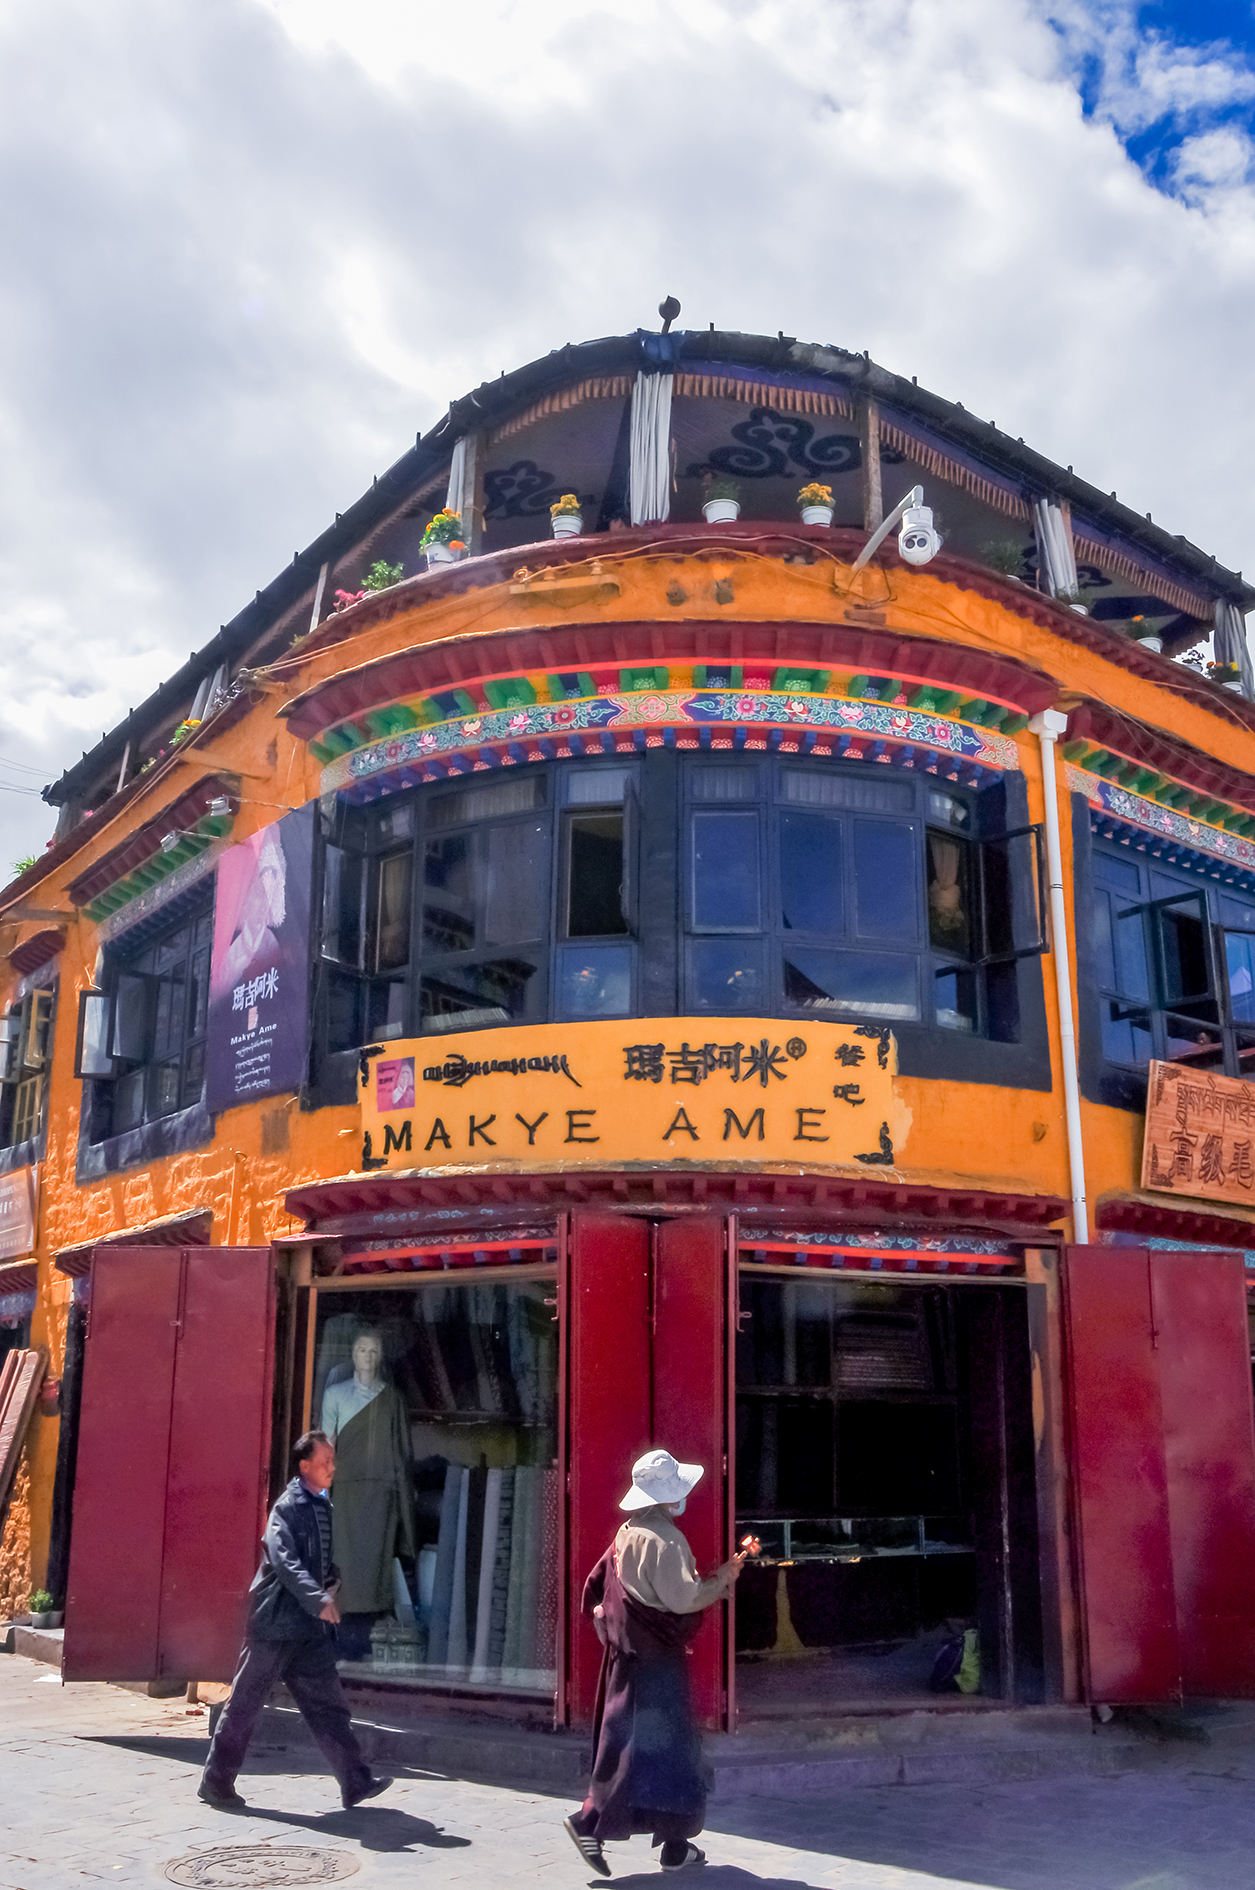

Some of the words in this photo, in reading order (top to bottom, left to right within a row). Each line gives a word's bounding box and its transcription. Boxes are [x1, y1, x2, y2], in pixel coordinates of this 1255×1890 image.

[230, 1031, 256, 1046] Makye
[258, 1023, 277, 1035] Ame
[383, 1110, 600, 1155] MAKYE
[662, 1107, 830, 1142] AME
